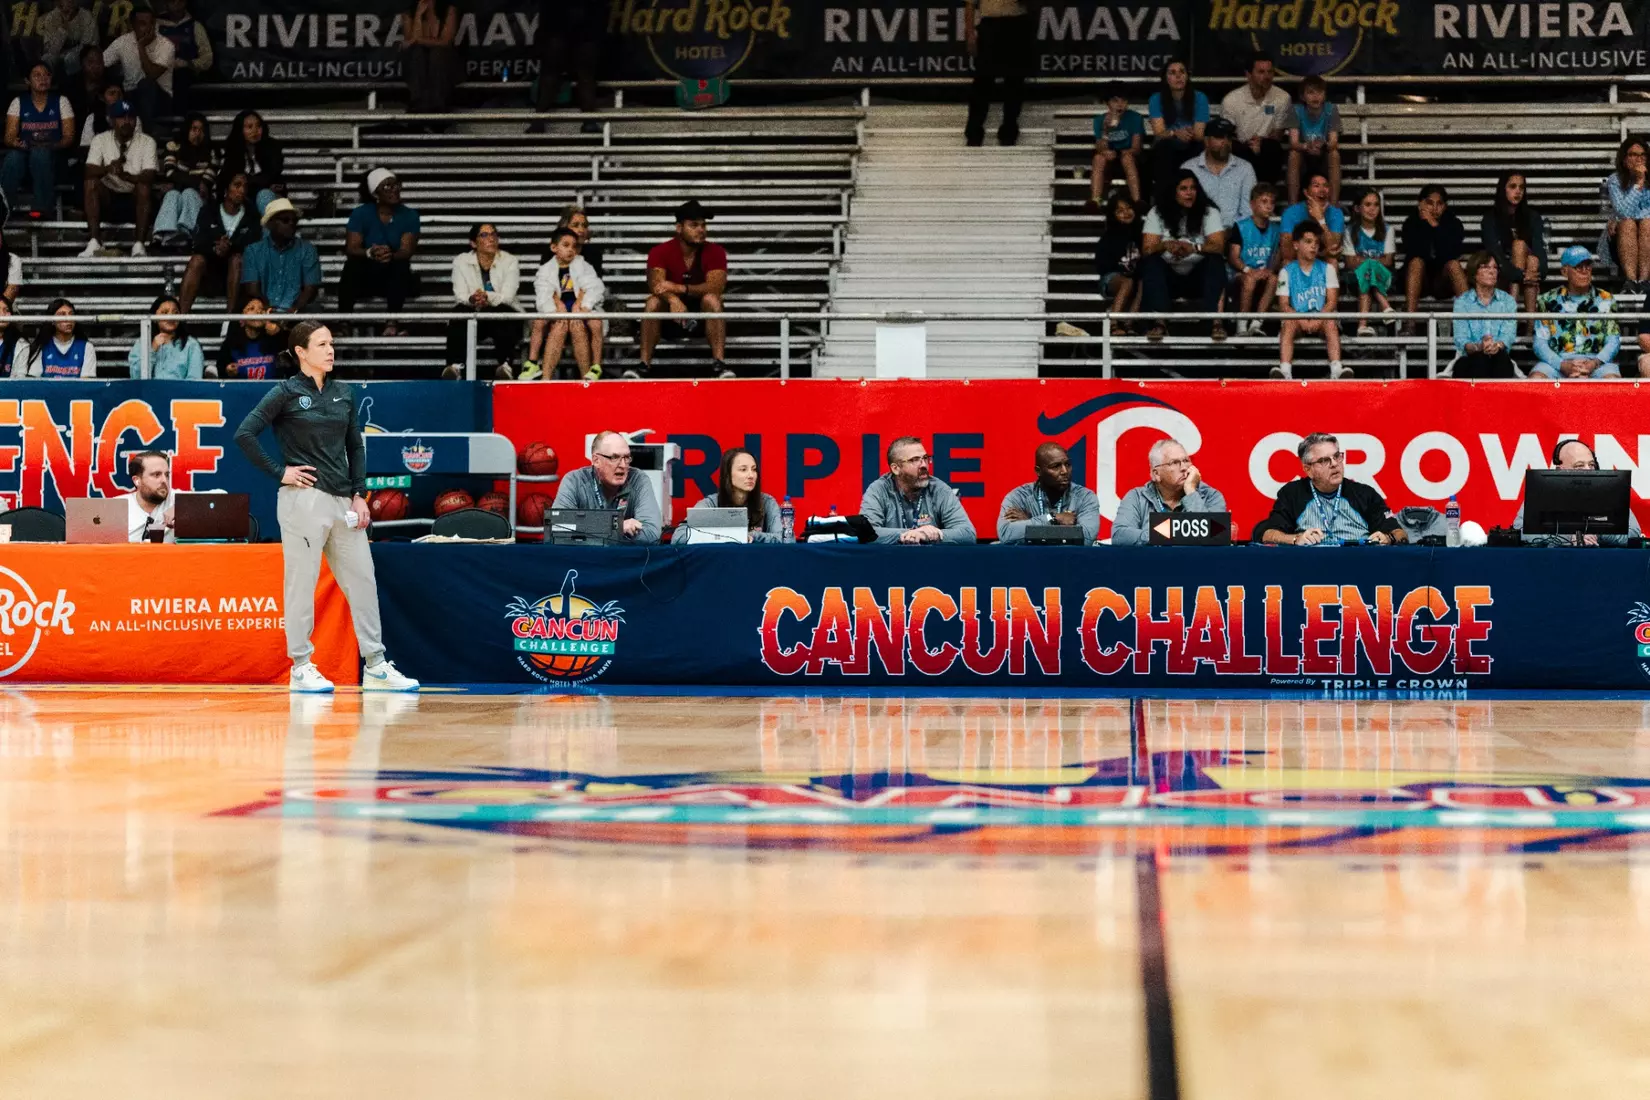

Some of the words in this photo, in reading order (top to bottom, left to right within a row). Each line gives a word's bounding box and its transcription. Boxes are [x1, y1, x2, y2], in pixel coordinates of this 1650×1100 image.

[607, 0, 699, 34] Hard
[704, 0, 792, 39] Rock
[1037, 5, 1181, 41] MAYA
[1208, 0, 1304, 30] Hard
[1308, 0, 1399, 37] Rock
[1434, 2, 1634, 40] RIVIERA
[225, 13, 405, 48] RIVIERA
[675, 45, 727, 60] HOTEL
[1280, 42, 1335, 57] HOTEL
[232, 61, 264, 78] AN
[271, 60, 402, 78] ALL-INCLUSI
[832, 56, 864, 72] AN
[1442, 53, 1474, 70] AN
[1482, 50, 1647, 69] ALL-INCLUSIVE
[1172, 519, 1208, 537] POSS
[130, 598, 212, 614] RIVIERA
[218, 597, 278, 613] MAYA
[89, 620, 111, 632] AN
[116, 618, 222, 632] ALL-INCLUSIVE
[227, 617, 286, 630] EXPERIE
[511, 617, 619, 641] CANCUN
[758, 586, 1062, 676] CANCUN
[1077, 585, 1494, 676] CHALLENGE
[519, 640, 609, 653] CHALLENGE
[531, 670, 548, 682] ROCK
[597, 659, 613, 676] MAYA
[1270, 677, 1304, 685] Powered
[1306, 677, 1317, 686] By
[1321, 679, 1387, 689] TRIPLE
[1396, 678, 1468, 689] CROWN
